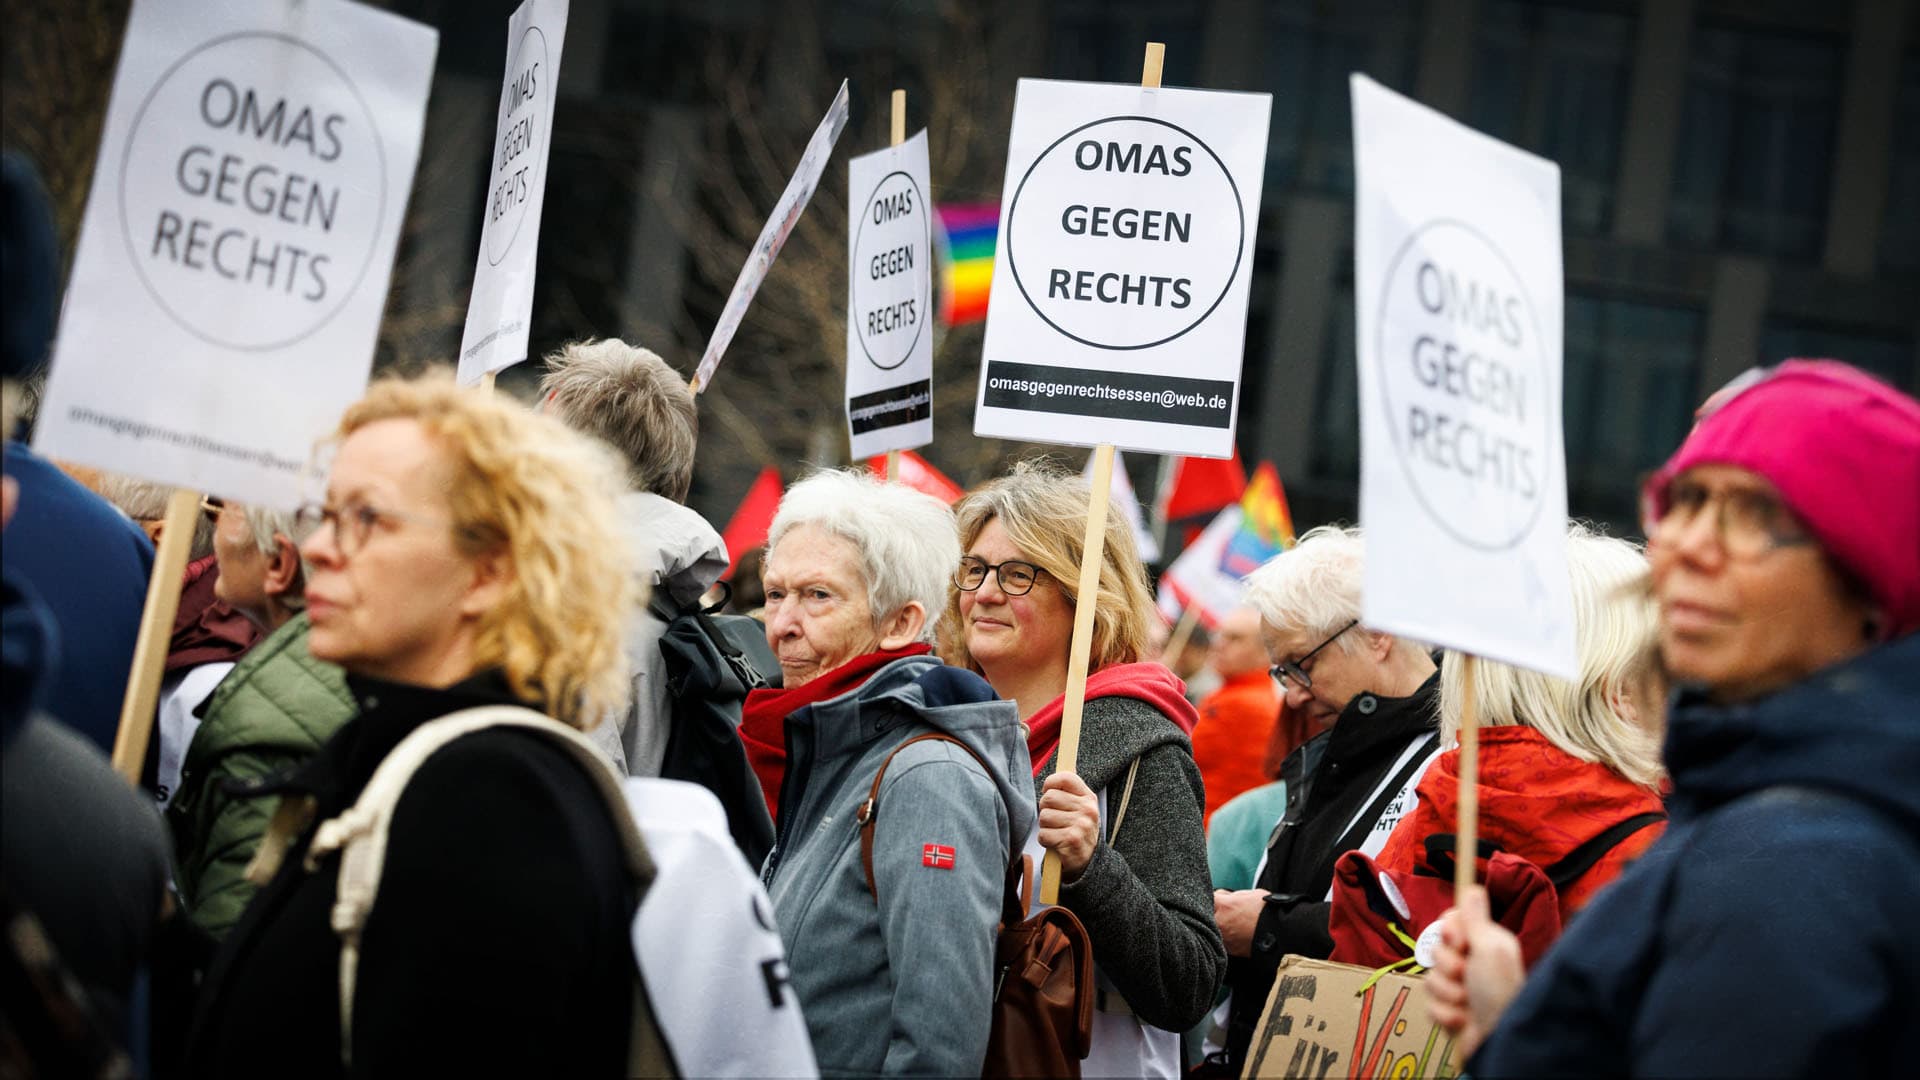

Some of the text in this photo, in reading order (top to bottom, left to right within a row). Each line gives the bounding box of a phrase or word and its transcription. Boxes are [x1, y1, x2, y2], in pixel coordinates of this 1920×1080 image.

[507, 62, 539, 118] OMAS
[199, 77, 346, 162] OMAS
[1074, 140, 1192, 177] OMAS
[176, 144, 339, 233] GEGEN
[873, 188, 912, 225] OMAS
[1061, 204, 1192, 243] GEGEN
[151, 210, 334, 303] RECHTS
[870, 243, 914, 280] GEGEN
[1048, 268, 1192, 309] RECHTS
[1416, 260, 1523, 348] OMAS
[868, 299, 916, 337] RECHTS
[989, 376, 1227, 409] omasgegenrechtsessen@web.de
[1411, 335, 1526, 424] GEGEN
[1407, 405, 1536, 502] RECHTS
[1252, 975, 1338, 1080] Für
